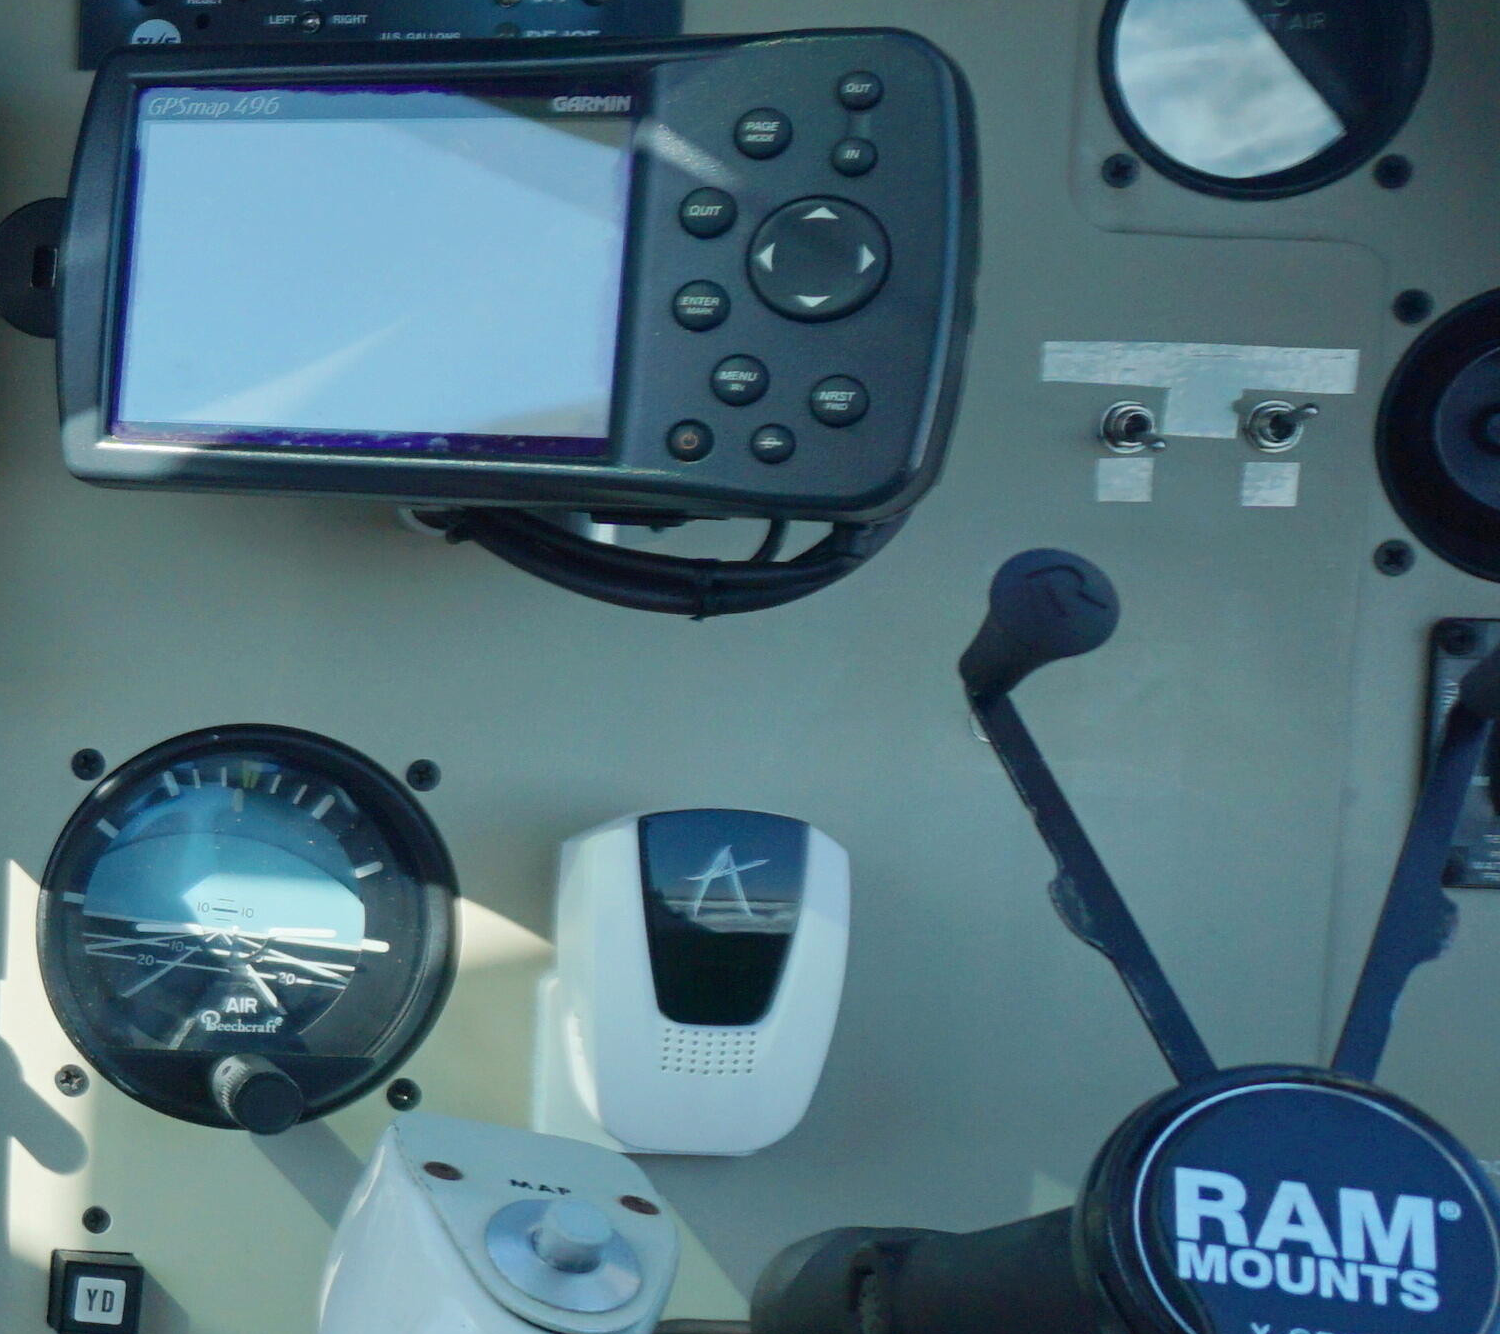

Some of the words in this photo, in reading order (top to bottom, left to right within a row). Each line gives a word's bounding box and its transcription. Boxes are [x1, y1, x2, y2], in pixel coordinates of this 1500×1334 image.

[148, 97, 230, 117] GPSmap
[234, 96, 281, 113] 496
[552, 95, 632, 111] GARMIN
[1174, 1166, 1437, 1271] RAM
[1178, 1241, 1439, 1311] MOUNTS
[87, 1289, 114, 1312] YD
